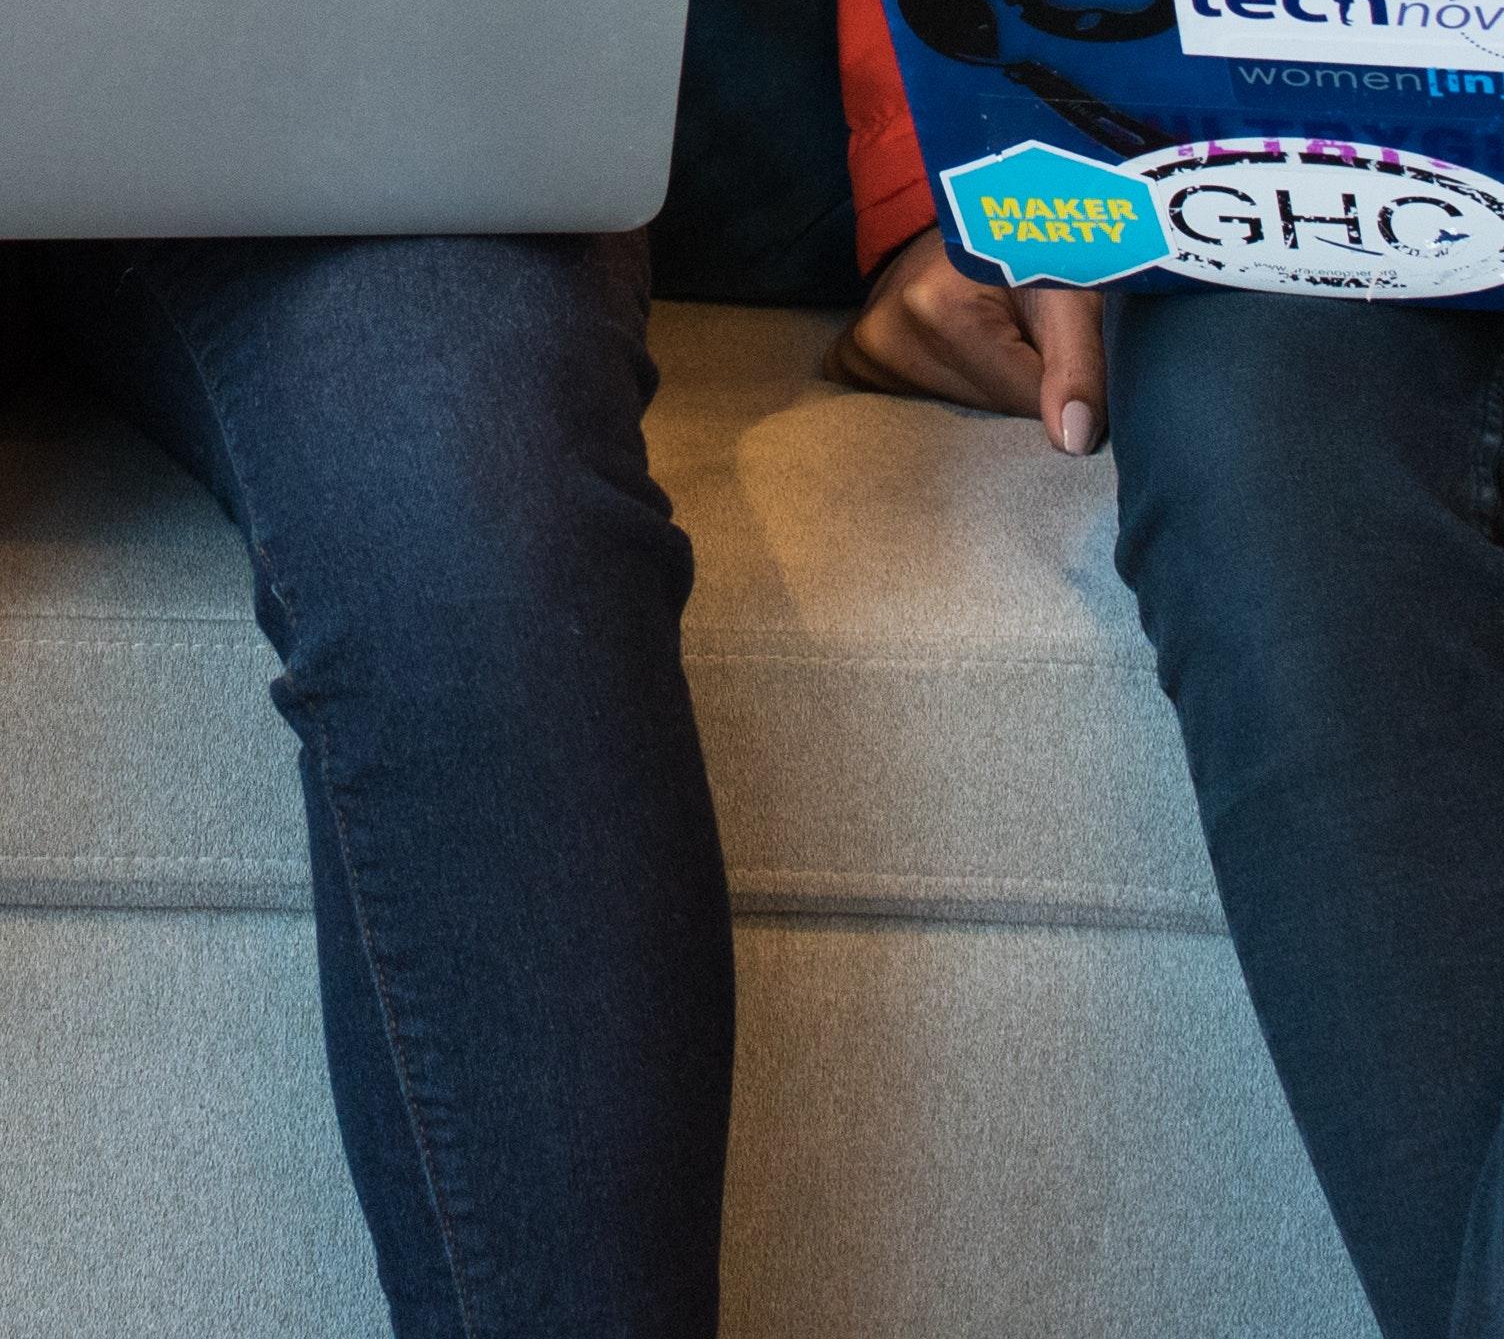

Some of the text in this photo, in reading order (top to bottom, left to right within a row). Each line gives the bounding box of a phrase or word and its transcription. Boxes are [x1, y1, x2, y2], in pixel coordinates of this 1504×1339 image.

[980, 196, 1139, 221] MAKER
[988, 219, 1126, 244] PARTY
[1168, 184, 1464, 259] GHC
